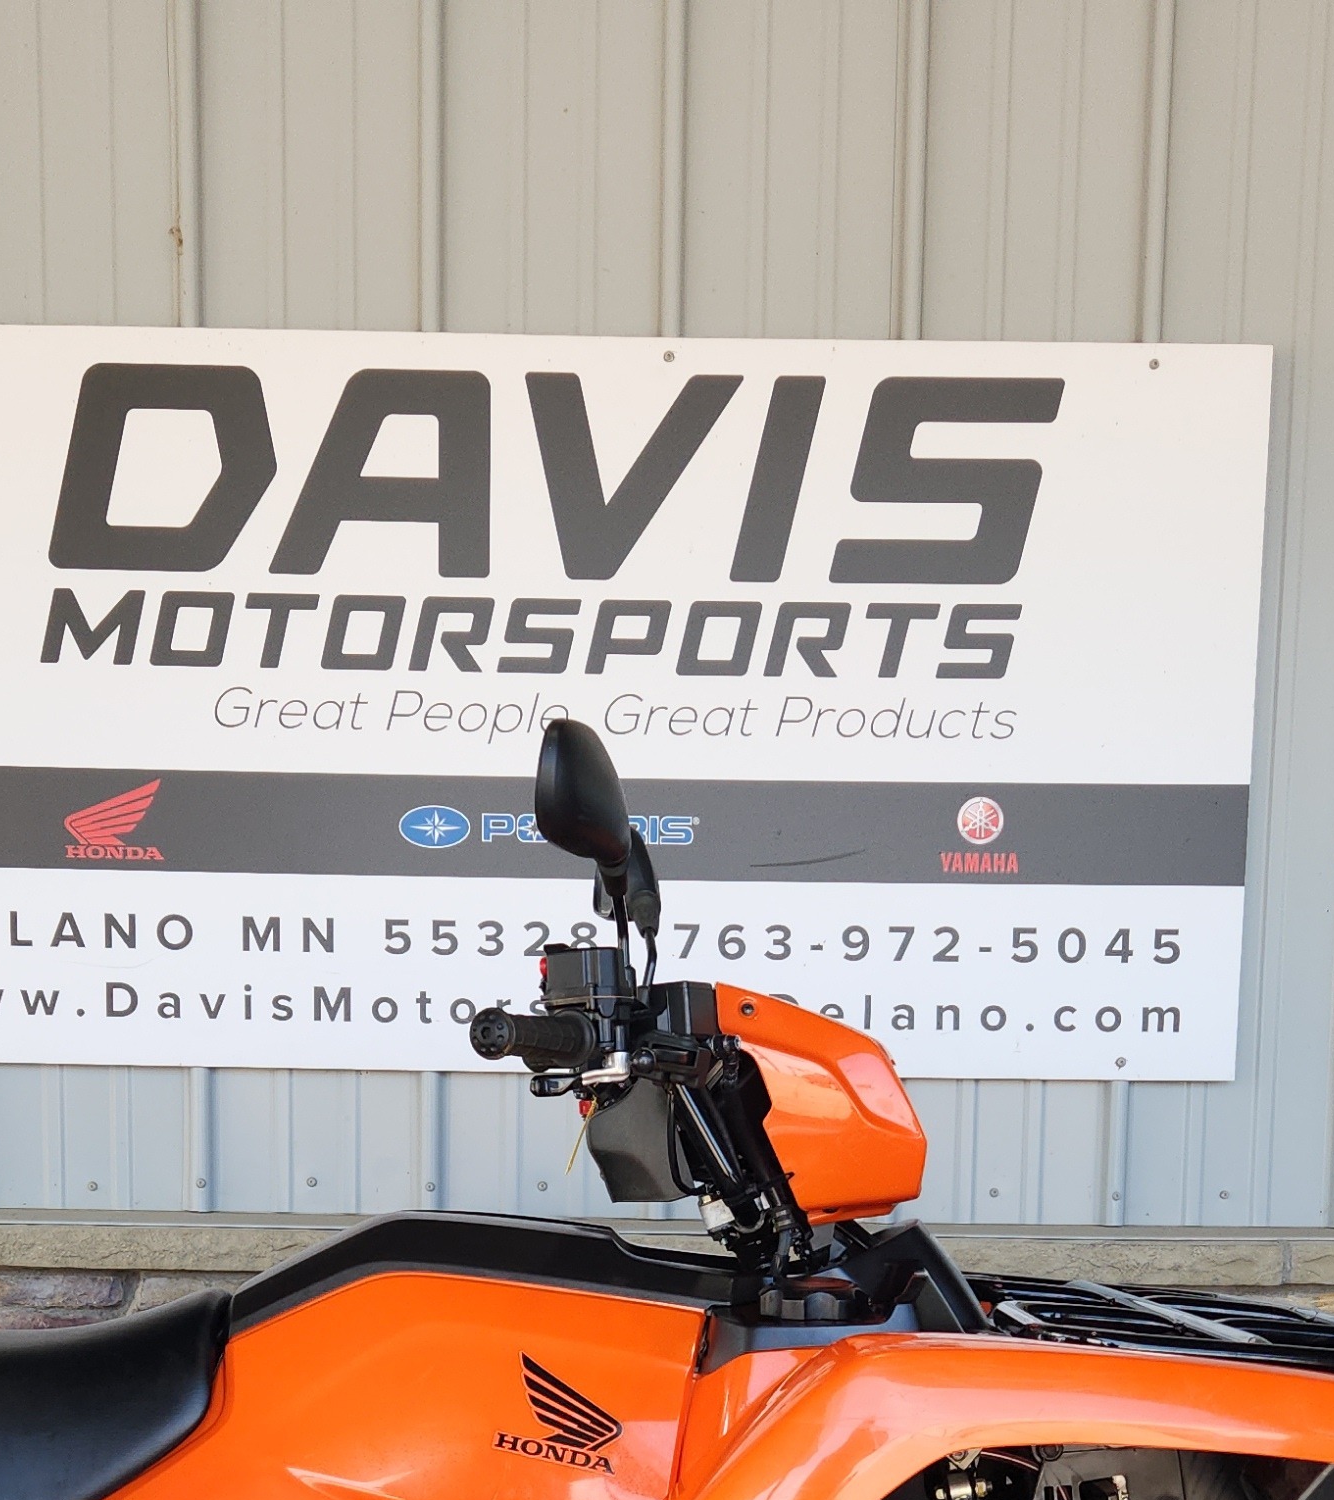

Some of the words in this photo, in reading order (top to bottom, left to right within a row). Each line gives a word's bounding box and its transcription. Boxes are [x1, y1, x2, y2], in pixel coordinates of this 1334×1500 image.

[48, 362, 1066, 585] DAVIS
[40, 587, 1023, 679] MOTORSPORTS
[214, 686, 369, 731] Great
[604, 693, 759, 737] Great
[774, 696, 1018, 740] Products
[65, 844, 164, 861] HONDA
[940, 851, 1019, 874] YAMAHA
[242, 916, 334, 953] MN
[384, 919, 599, 957] 55328
[673, 923, 1181, 965] 763-972-5045
[494, 1432, 616, 1475] HONDA
